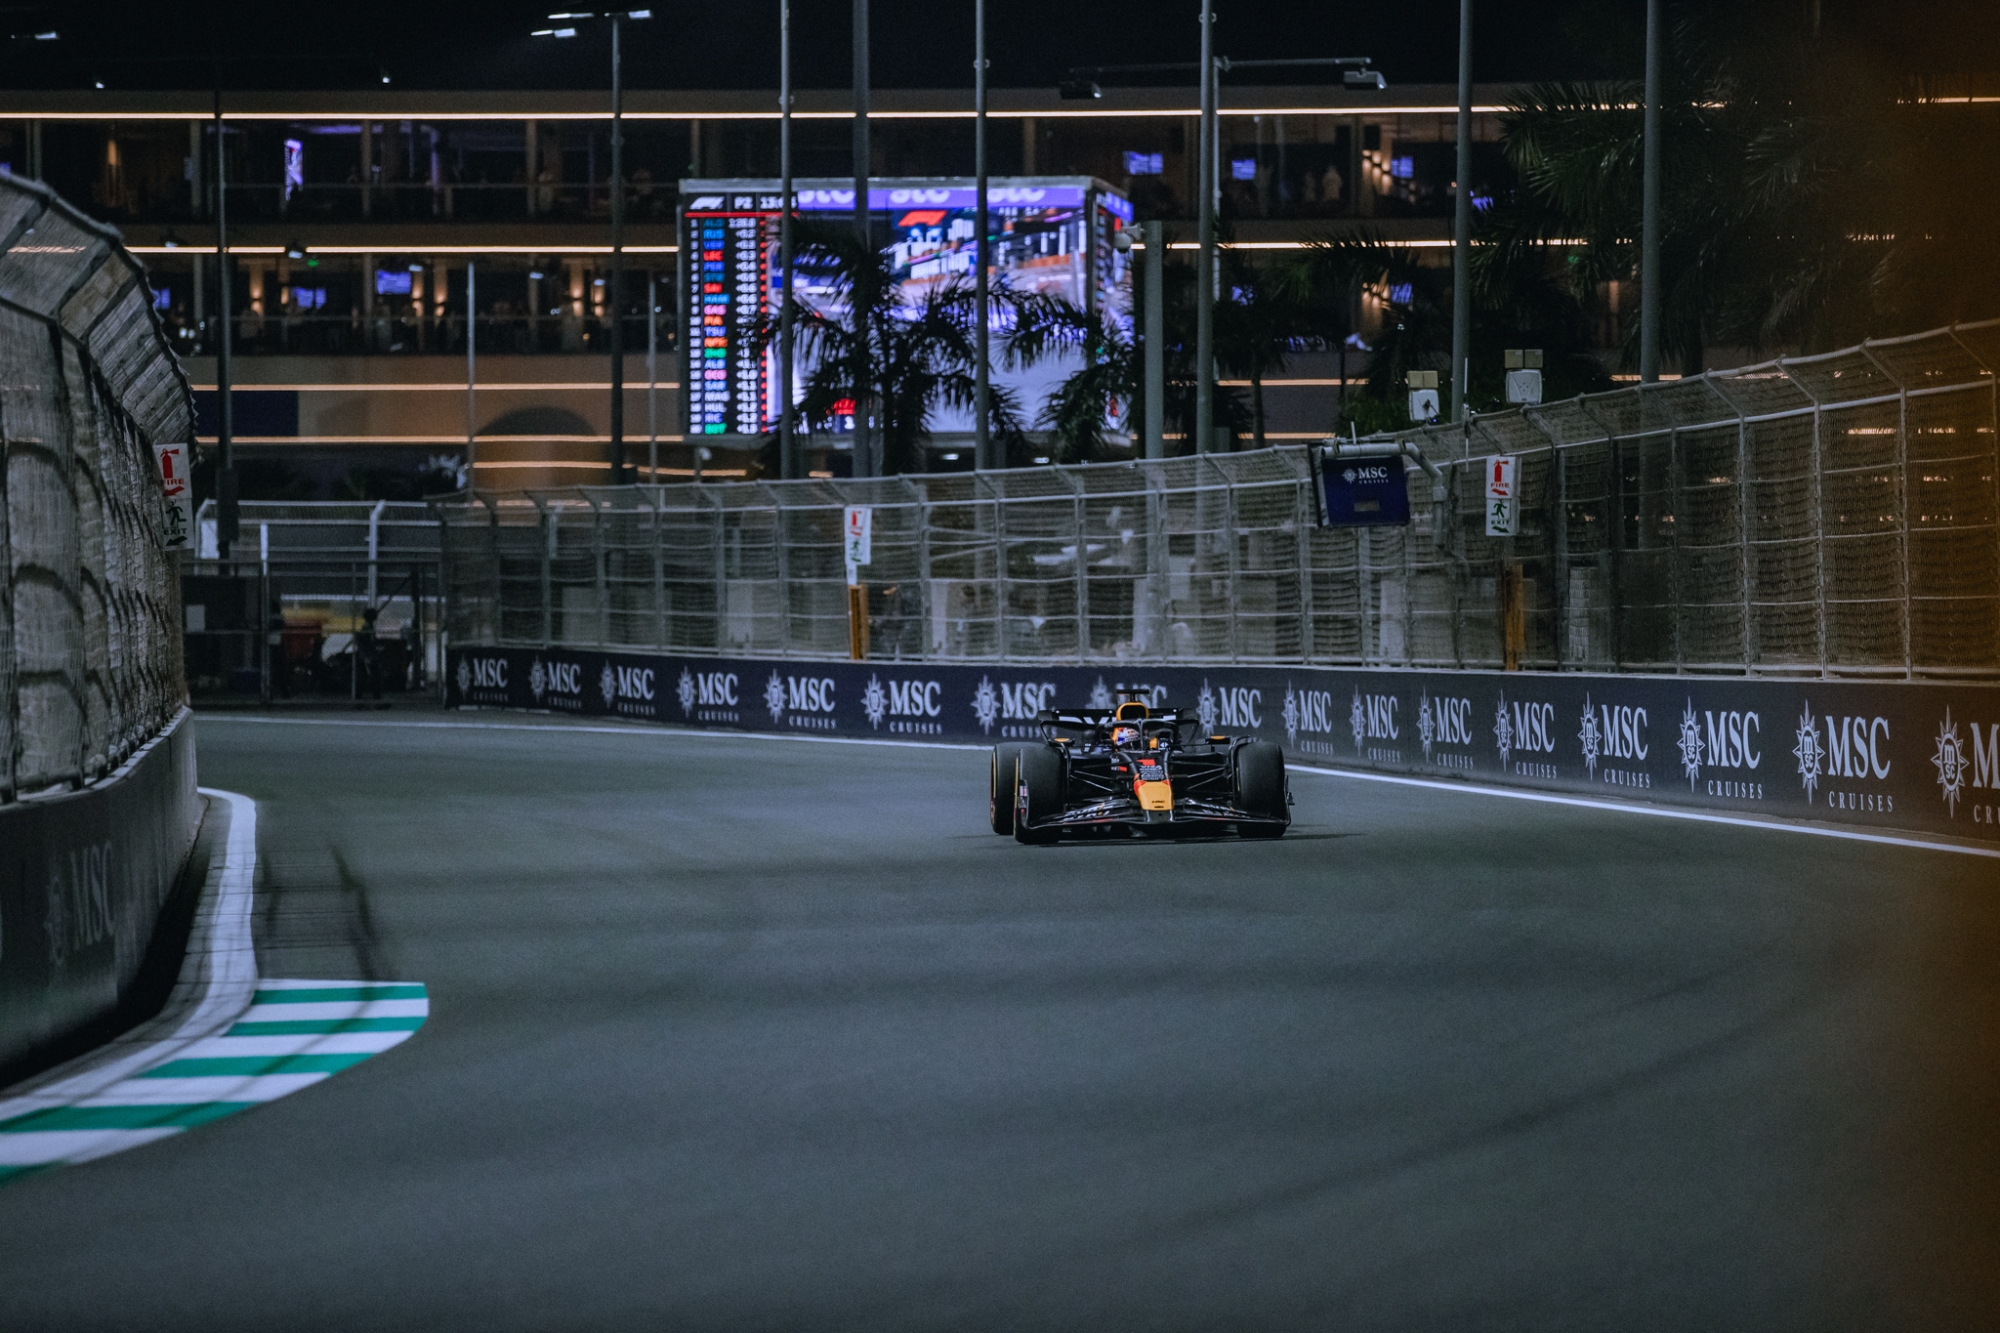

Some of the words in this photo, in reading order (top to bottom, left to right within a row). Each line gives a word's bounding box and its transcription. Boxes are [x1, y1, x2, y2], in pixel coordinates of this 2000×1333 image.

[1358, 466, 1388, 479] MSC
[474, 659, 508, 687] MSC
[548, 662, 581, 693] MSC
[618, 666, 655, 700] MSC
[697, 673, 739, 706] MSC
[788, 677, 836, 712] MSC
[889, 681, 941, 716] MSC
[698, 711, 739, 722] CRUISES
[1219, 687, 1262, 728] MSC
[1299, 690, 1332, 733] MSC
[1366, 695, 1399, 740] MSC
[1435, 697, 1472, 745] MSC
[789, 716, 836, 729] CRUISES
[890, 722, 942, 735] CRUISES
[1513, 702, 1555, 753] MSC
[1601, 704, 1649, 760] MSC
[1301, 740, 1334, 755] CRUISES
[1705, 711, 1761, 769] MSC
[1825, 716, 1891, 779] MSC
[1367, 748, 1401, 763] CRUISES
[1437, 753, 1474, 769] CRUISES
[1515, 762, 1557, 779] CRUISES
[1603, 768, 1651, 788] CRUISES
[1708, 780, 1763, 799] CRUISES
[1828, 790, 1893, 813] CRUISES
[1974, 804, 2000, 824] CR
